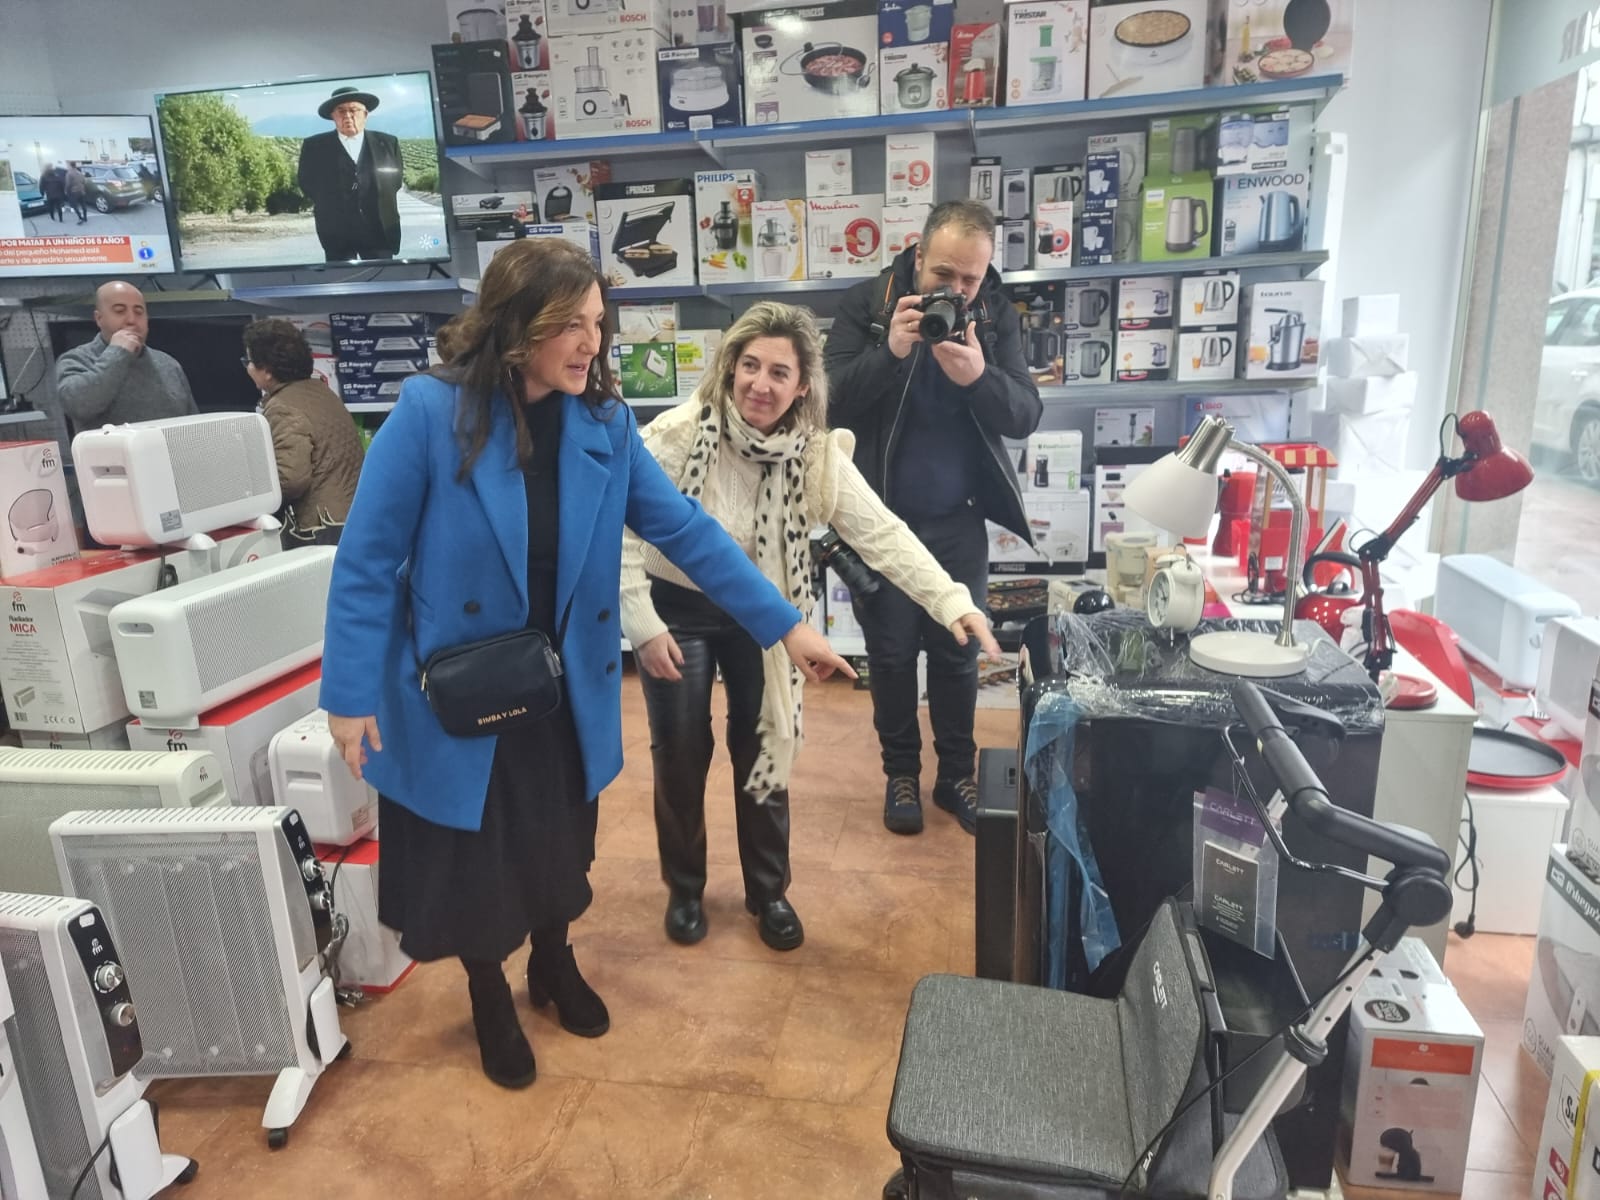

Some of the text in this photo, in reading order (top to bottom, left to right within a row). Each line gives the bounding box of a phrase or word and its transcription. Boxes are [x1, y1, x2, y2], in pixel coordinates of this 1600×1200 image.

[619, 14, 647, 24] BOSCH
[1013, 10, 1047, 20] TRISTAR
[625, 119, 652, 128] BOSCH
[697, 173, 735, 183] PHILIPS
[19, 238, 44, 246] MATAR
[65, 235, 85, 245] NIÑO
[103, 236, 125, 245] AÑOS
[41, 457, 55, 469] fm
[12, 601, 26, 612] fm
[10, 623, 37, 633] MICA
[508, 706, 528, 717] LOLA
[49, 741, 63, 750] fm
[166, 739, 188, 752] fm
